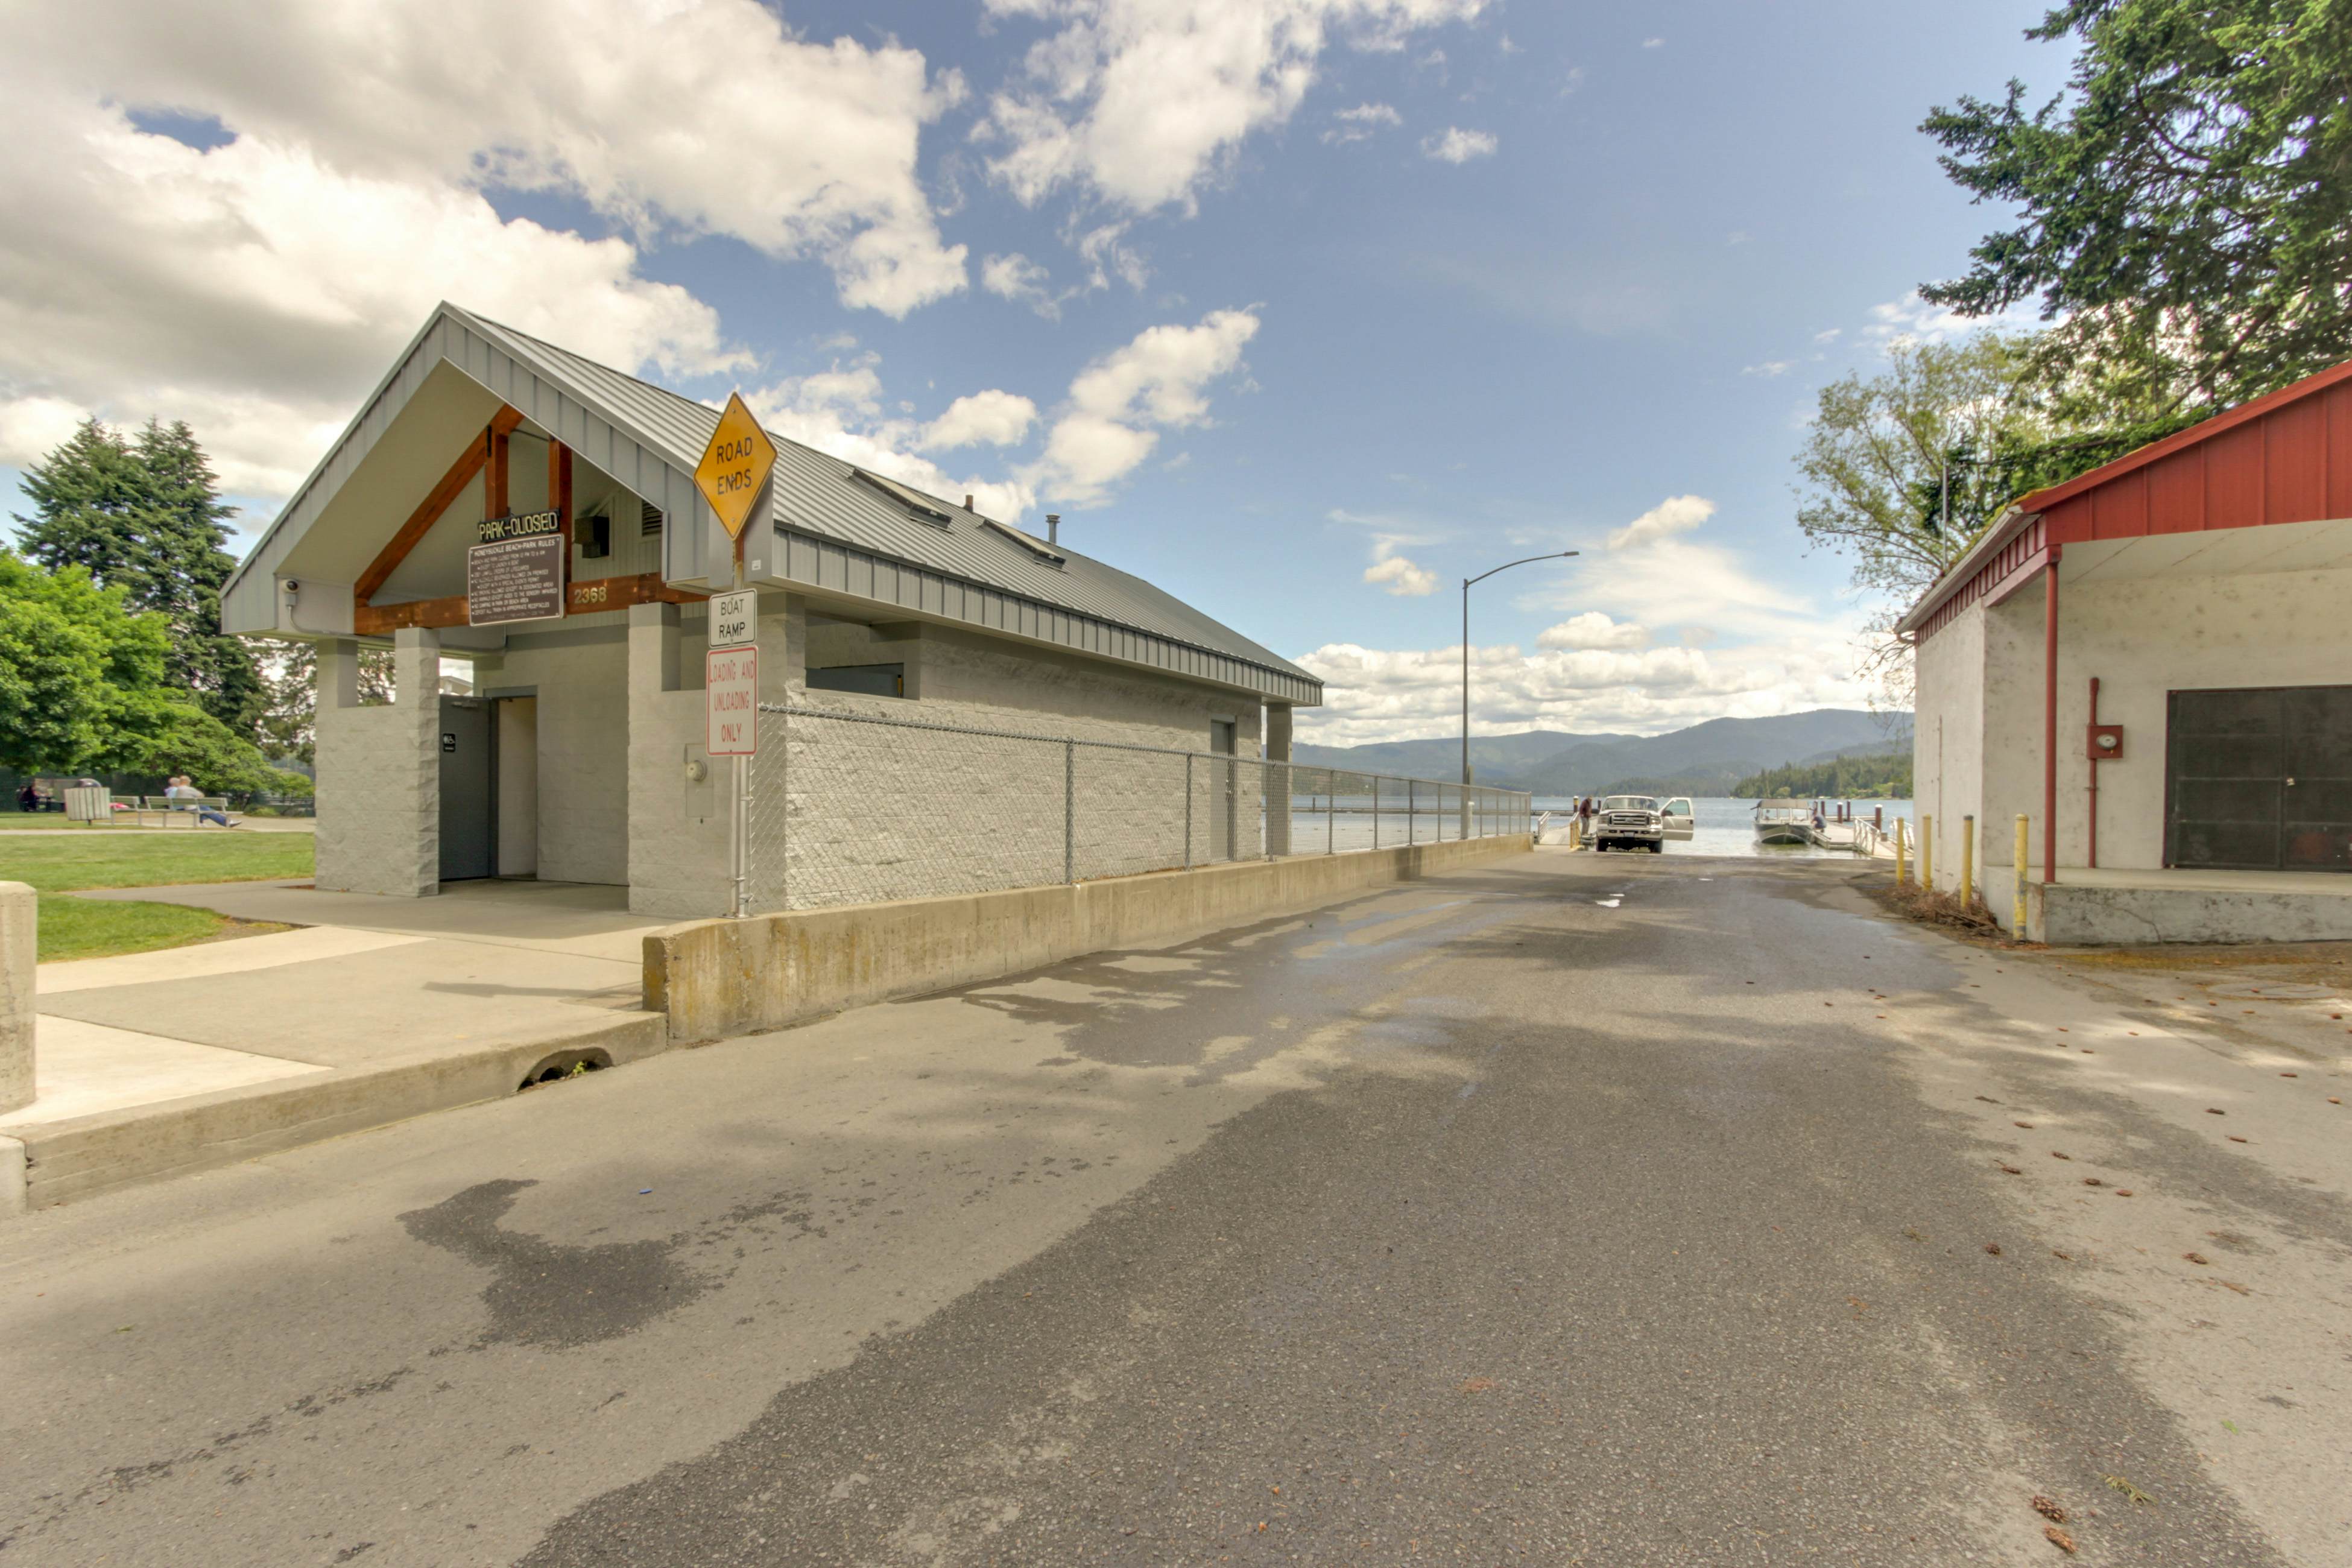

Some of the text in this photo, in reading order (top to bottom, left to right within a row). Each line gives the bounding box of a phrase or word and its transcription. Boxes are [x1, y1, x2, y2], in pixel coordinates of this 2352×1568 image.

[716, 437, 753, 464] ROAD
[717, 469, 751, 495] ENDS
[479, 511, 558, 541] PARK-CLOSED
[538, 539, 555, 548] RULES
[574, 586, 607, 604] 2368
[721, 599, 744, 616] BOAT
[719, 622, 745, 639] RAMP
[709, 660, 754, 683] LOADING AND
[714, 691, 749, 712] UNLOADING
[721, 723, 742, 742] ONLY
